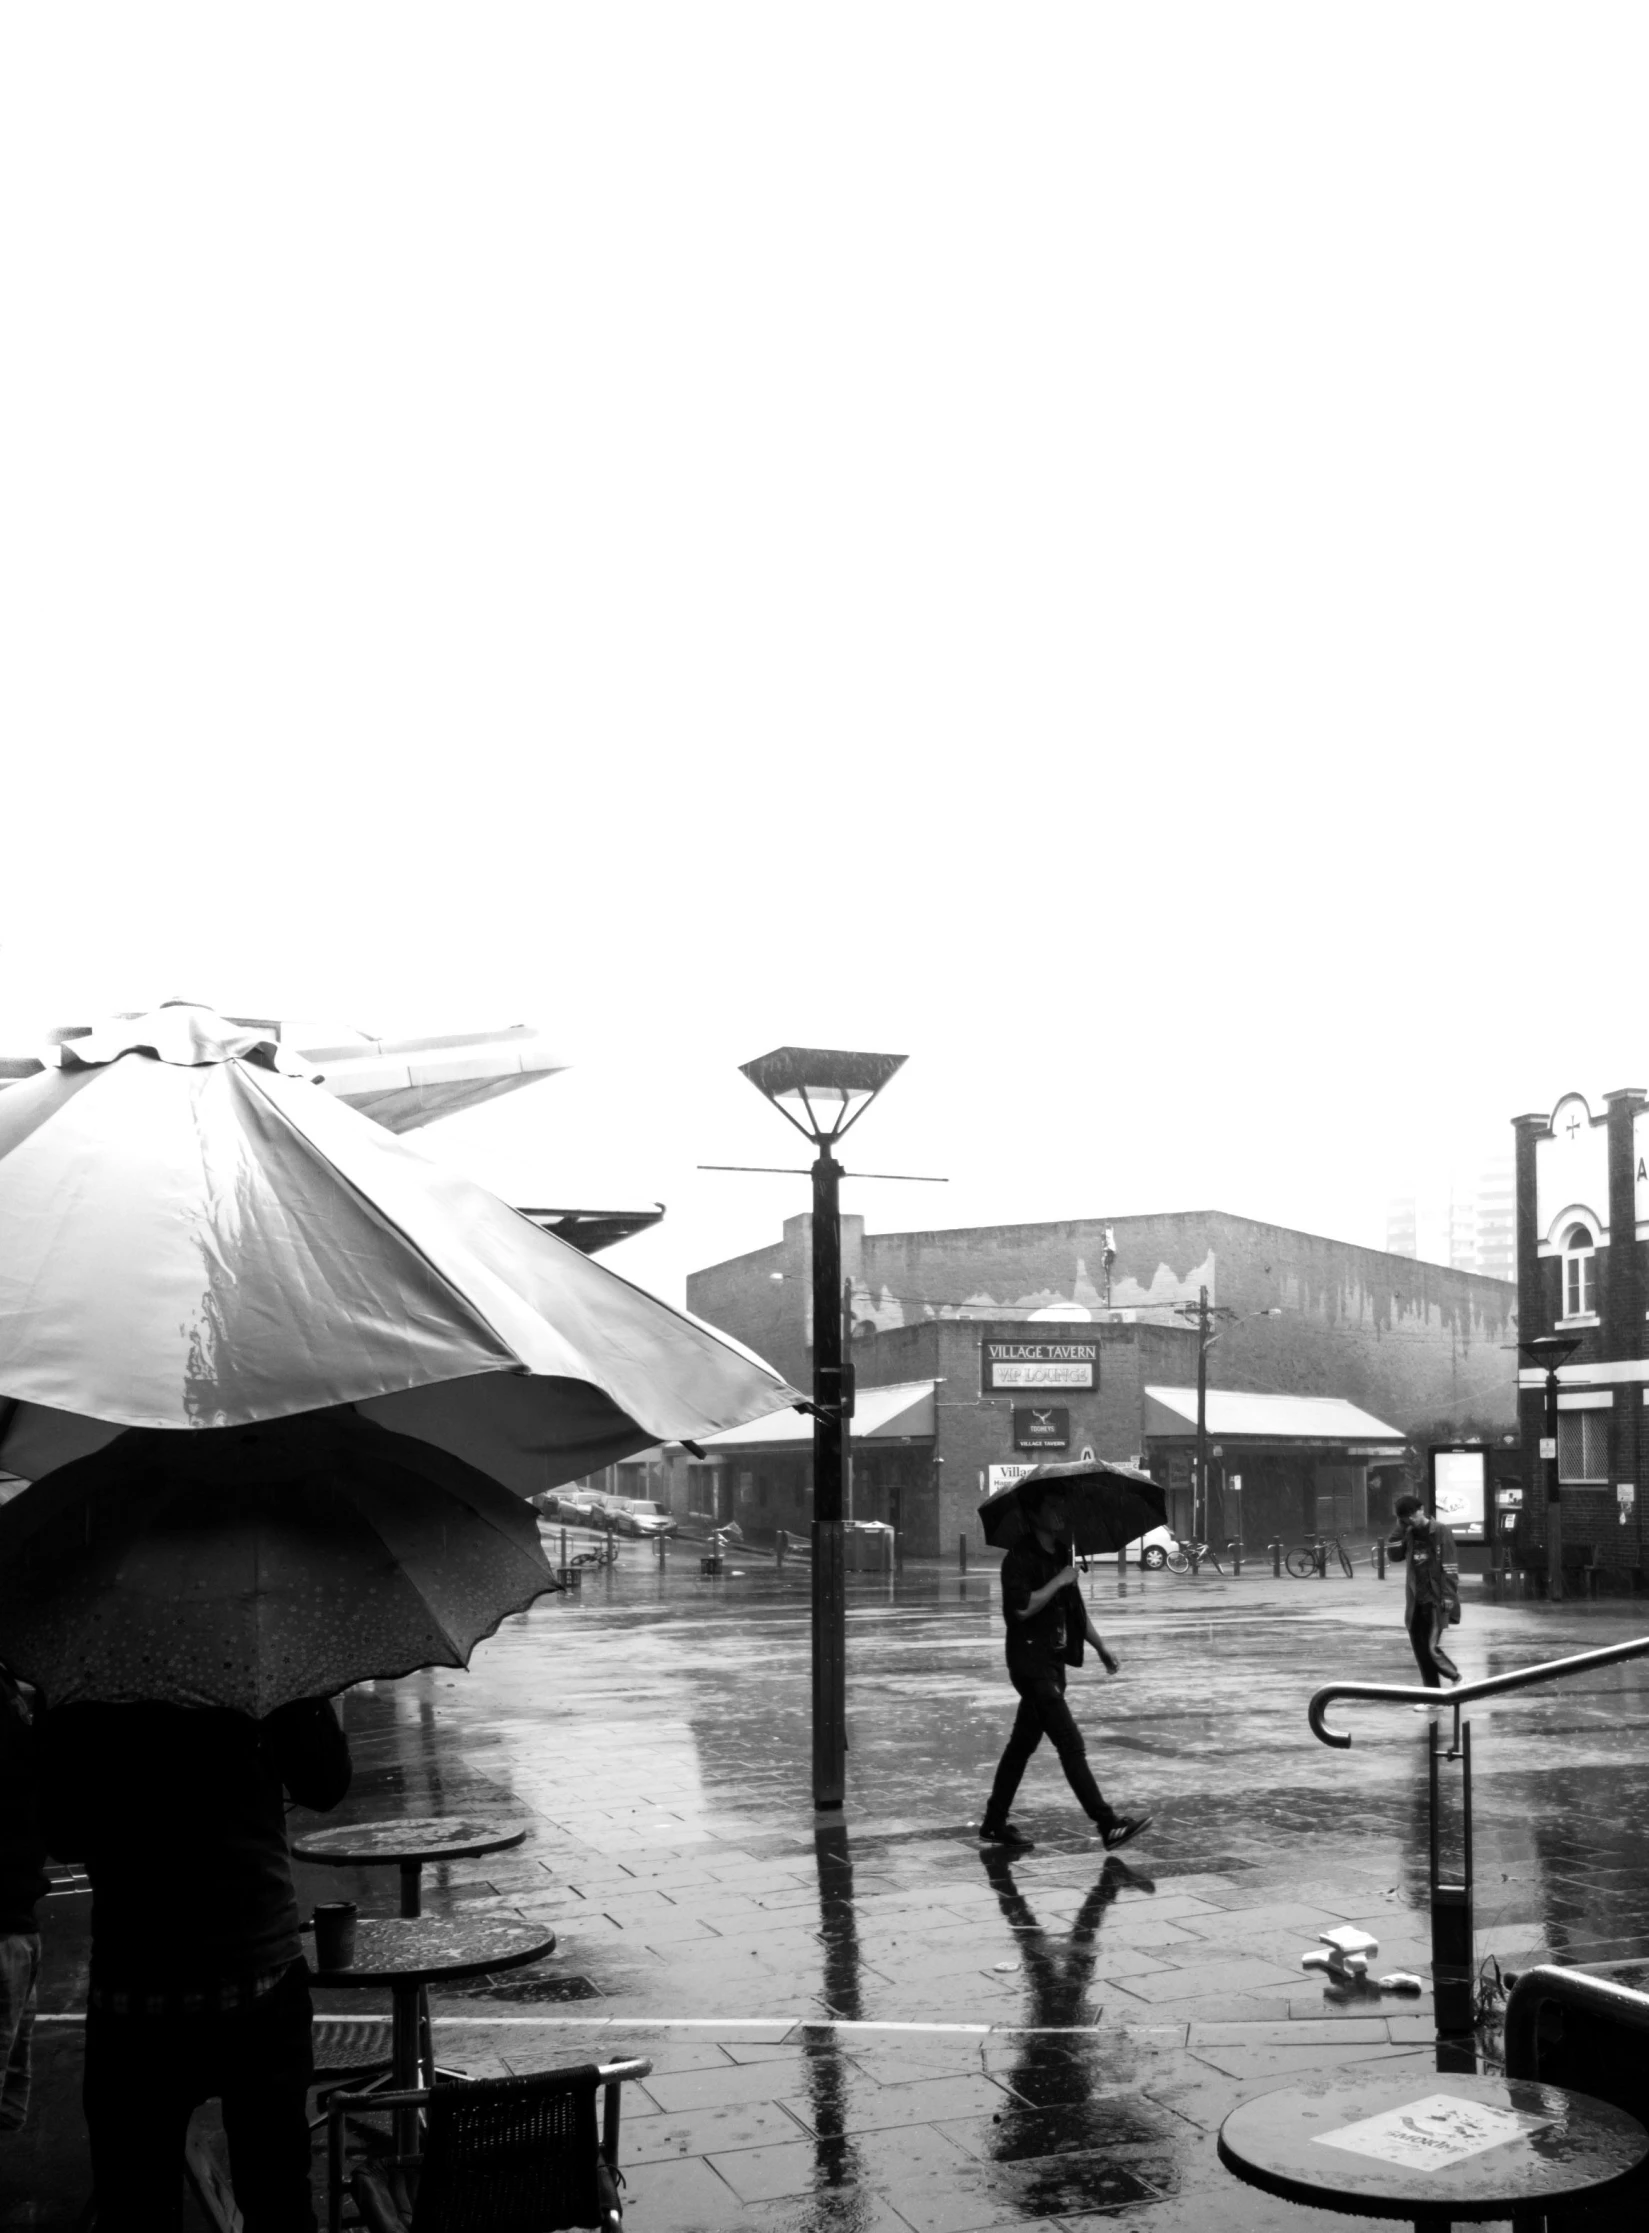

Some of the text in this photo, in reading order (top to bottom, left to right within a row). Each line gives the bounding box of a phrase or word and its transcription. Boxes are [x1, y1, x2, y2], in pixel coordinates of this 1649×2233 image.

[989, 1345, 1096, 1358] VILLAGE TAVERN
[997, 1367, 1088, 1383] VIP LOUNGE
